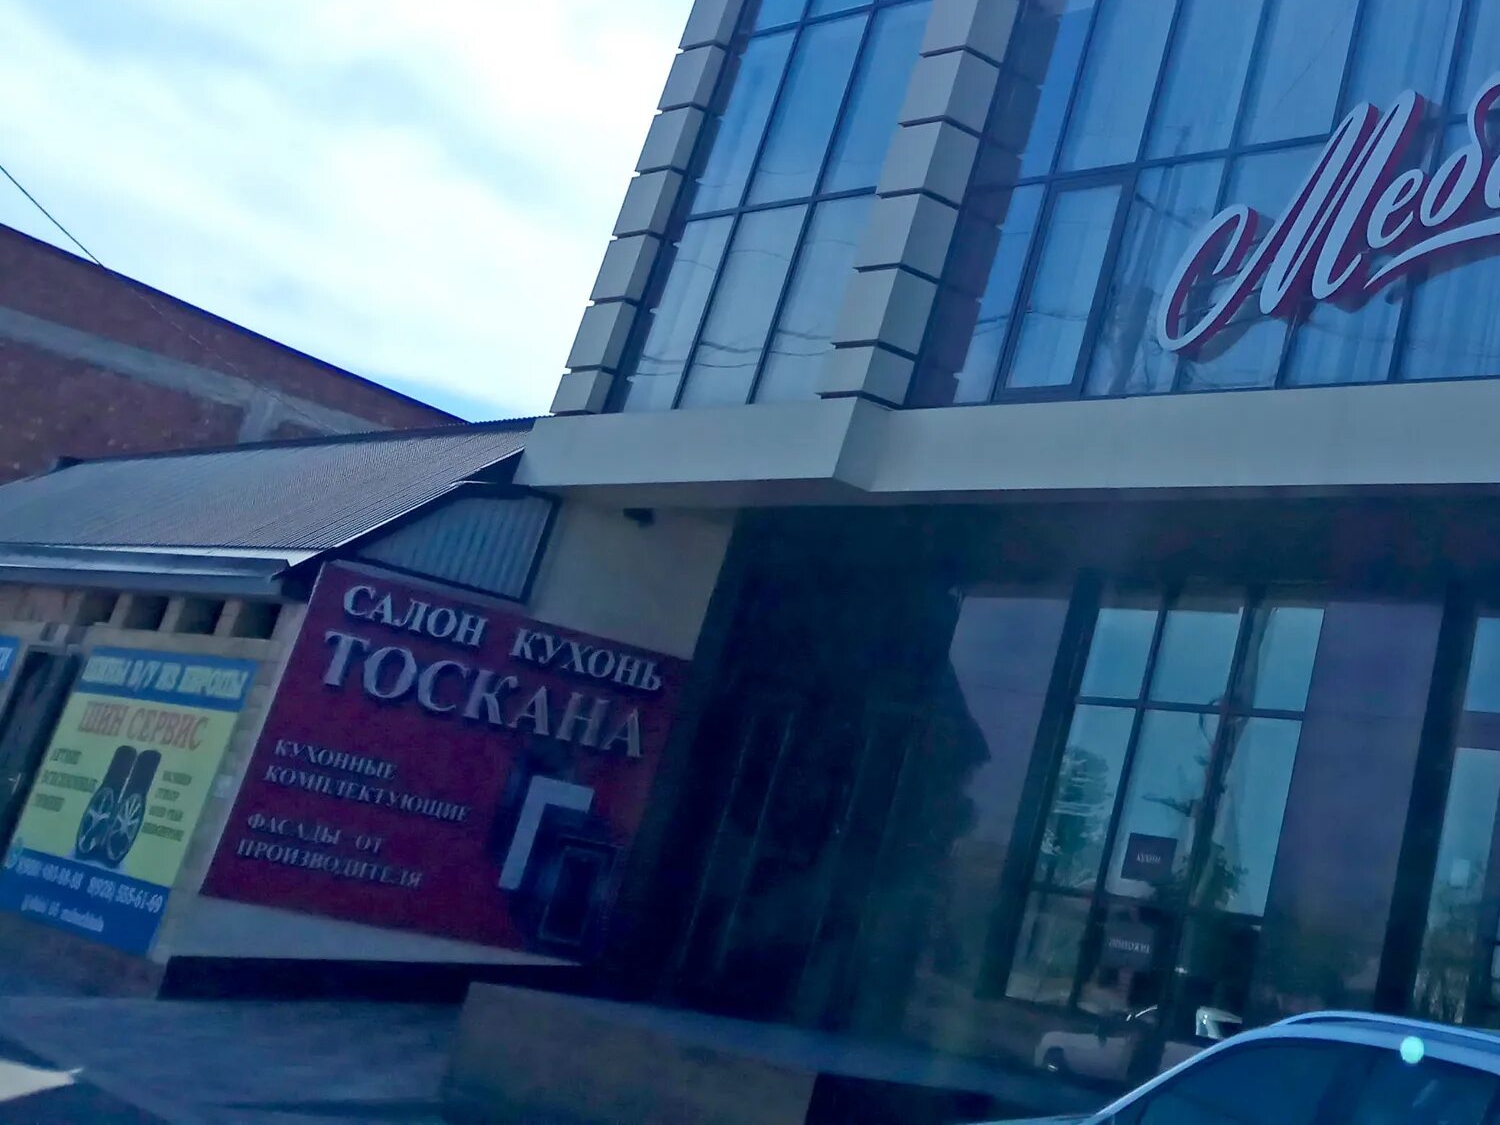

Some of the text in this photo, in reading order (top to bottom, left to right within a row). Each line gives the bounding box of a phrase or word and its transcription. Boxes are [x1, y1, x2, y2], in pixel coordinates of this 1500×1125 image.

[343, 585, 663, 692] САЛОН КУХОНЬ
[323, 630, 644, 759] ТОСКАНА
[127, 707, 210, 751] СЕРВИС
[274, 739, 398, 780] КУХОННЫЕ
[263, 765, 472, 822] КОМПЛЕКТУЮЩИЕ
[247, 812, 385, 854] ФАСАДЫ ОТ
[236, 838, 425, 888] ПРОИЗВОДИТЕЛЯ
